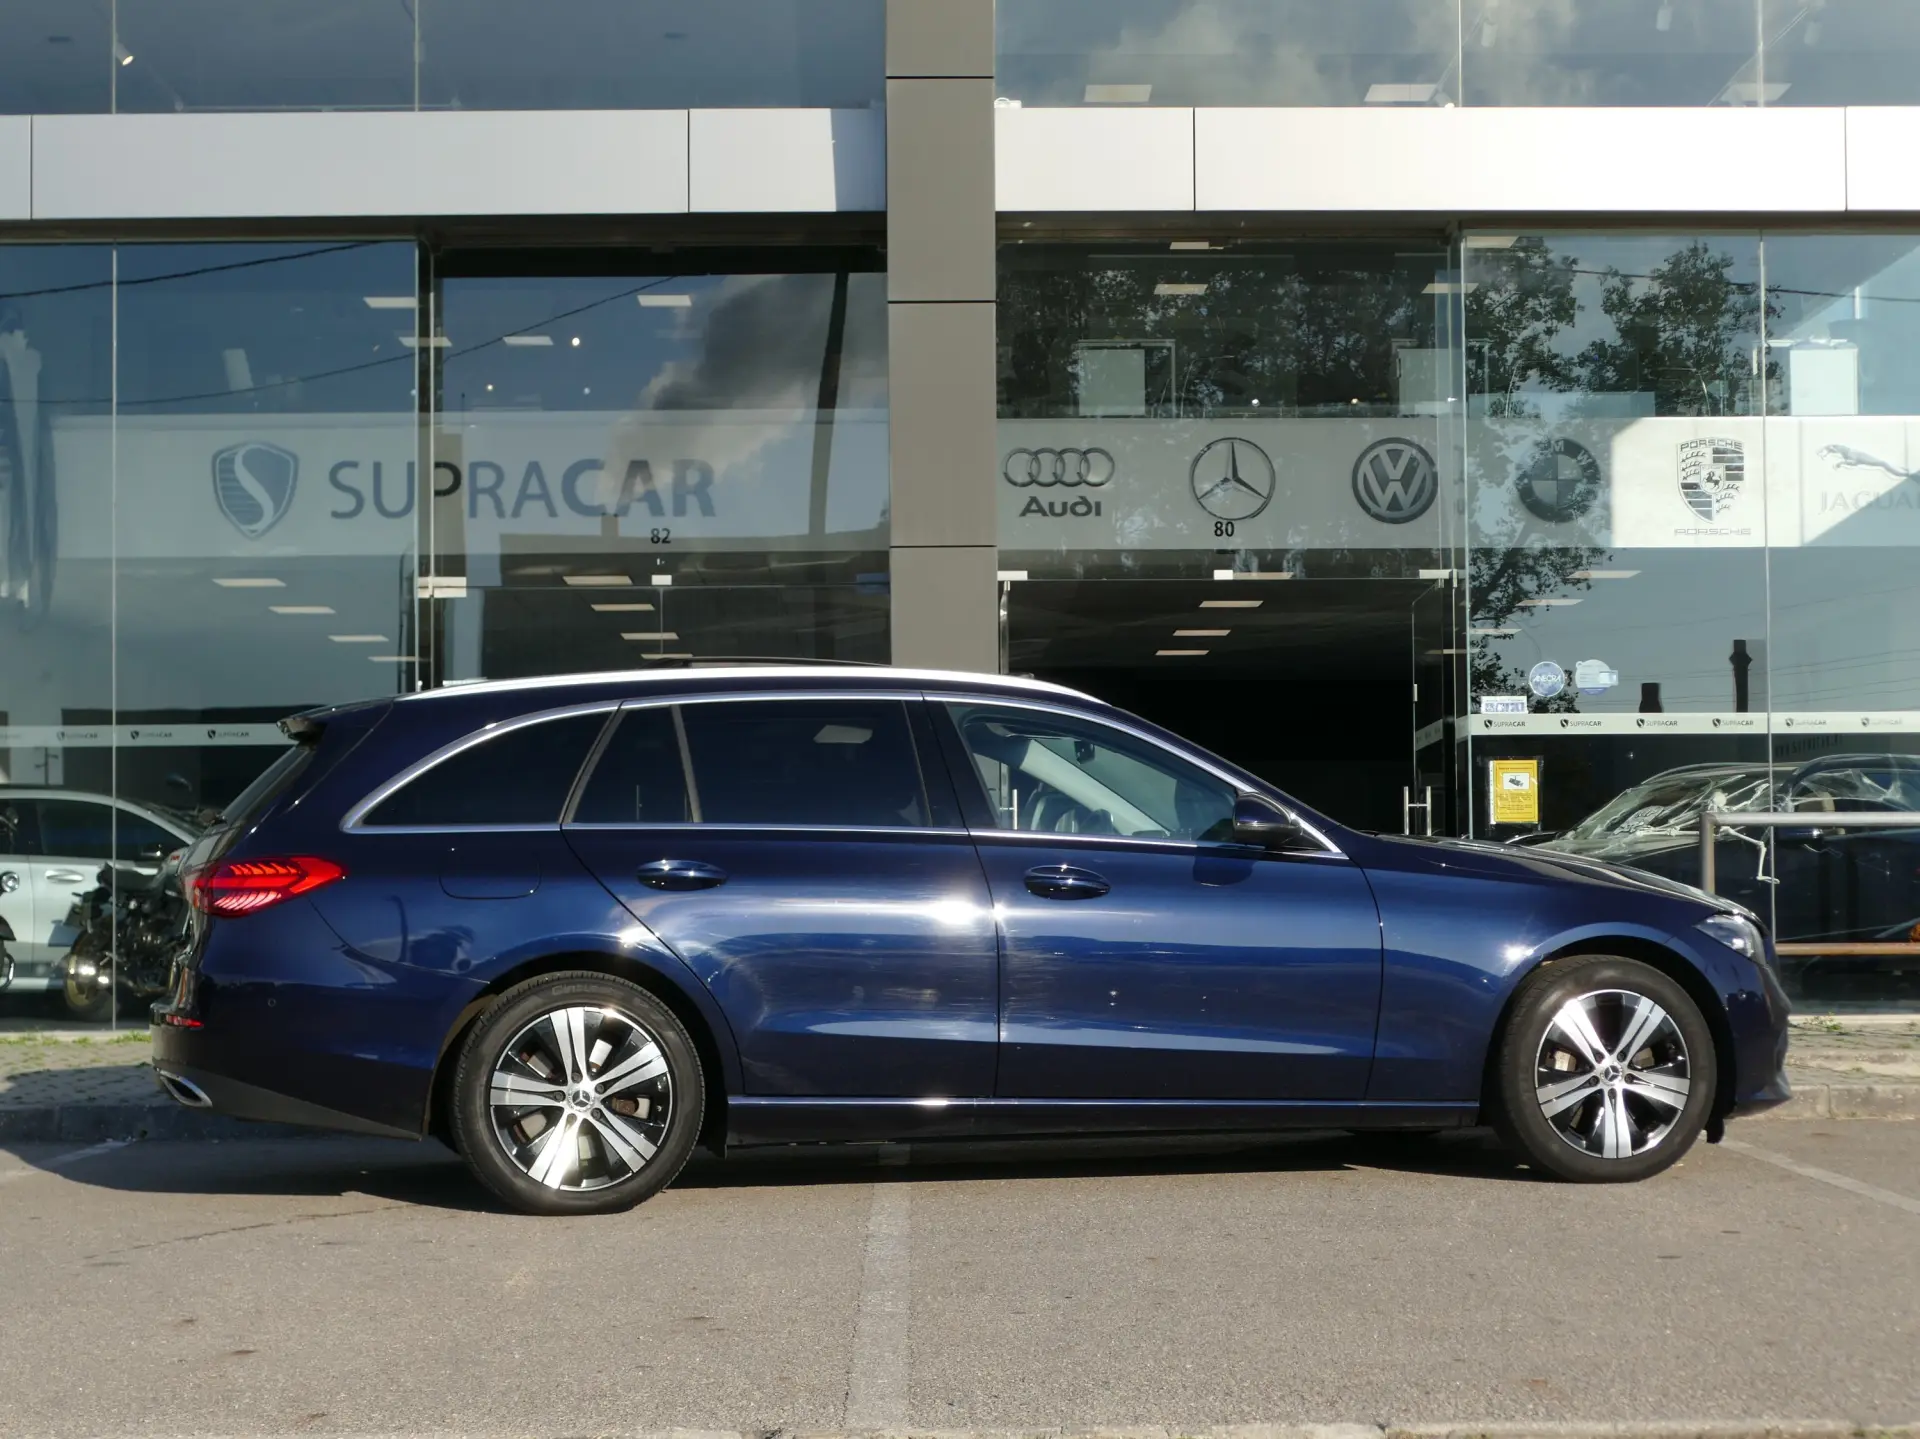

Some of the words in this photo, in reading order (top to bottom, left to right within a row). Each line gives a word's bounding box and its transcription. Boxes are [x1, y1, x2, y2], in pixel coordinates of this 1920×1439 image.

[1680, 439, 1743, 451] PORSCHE
[328, 458, 717, 520] SUPRACAR
[1018, 496, 1102, 517] Audi
[1817, 489, 1920, 515] JAGUA
[650, 527, 672, 545] 82
[1213, 521, 1235, 537] 80
[1674, 528, 1751, 536] PORSCHE
